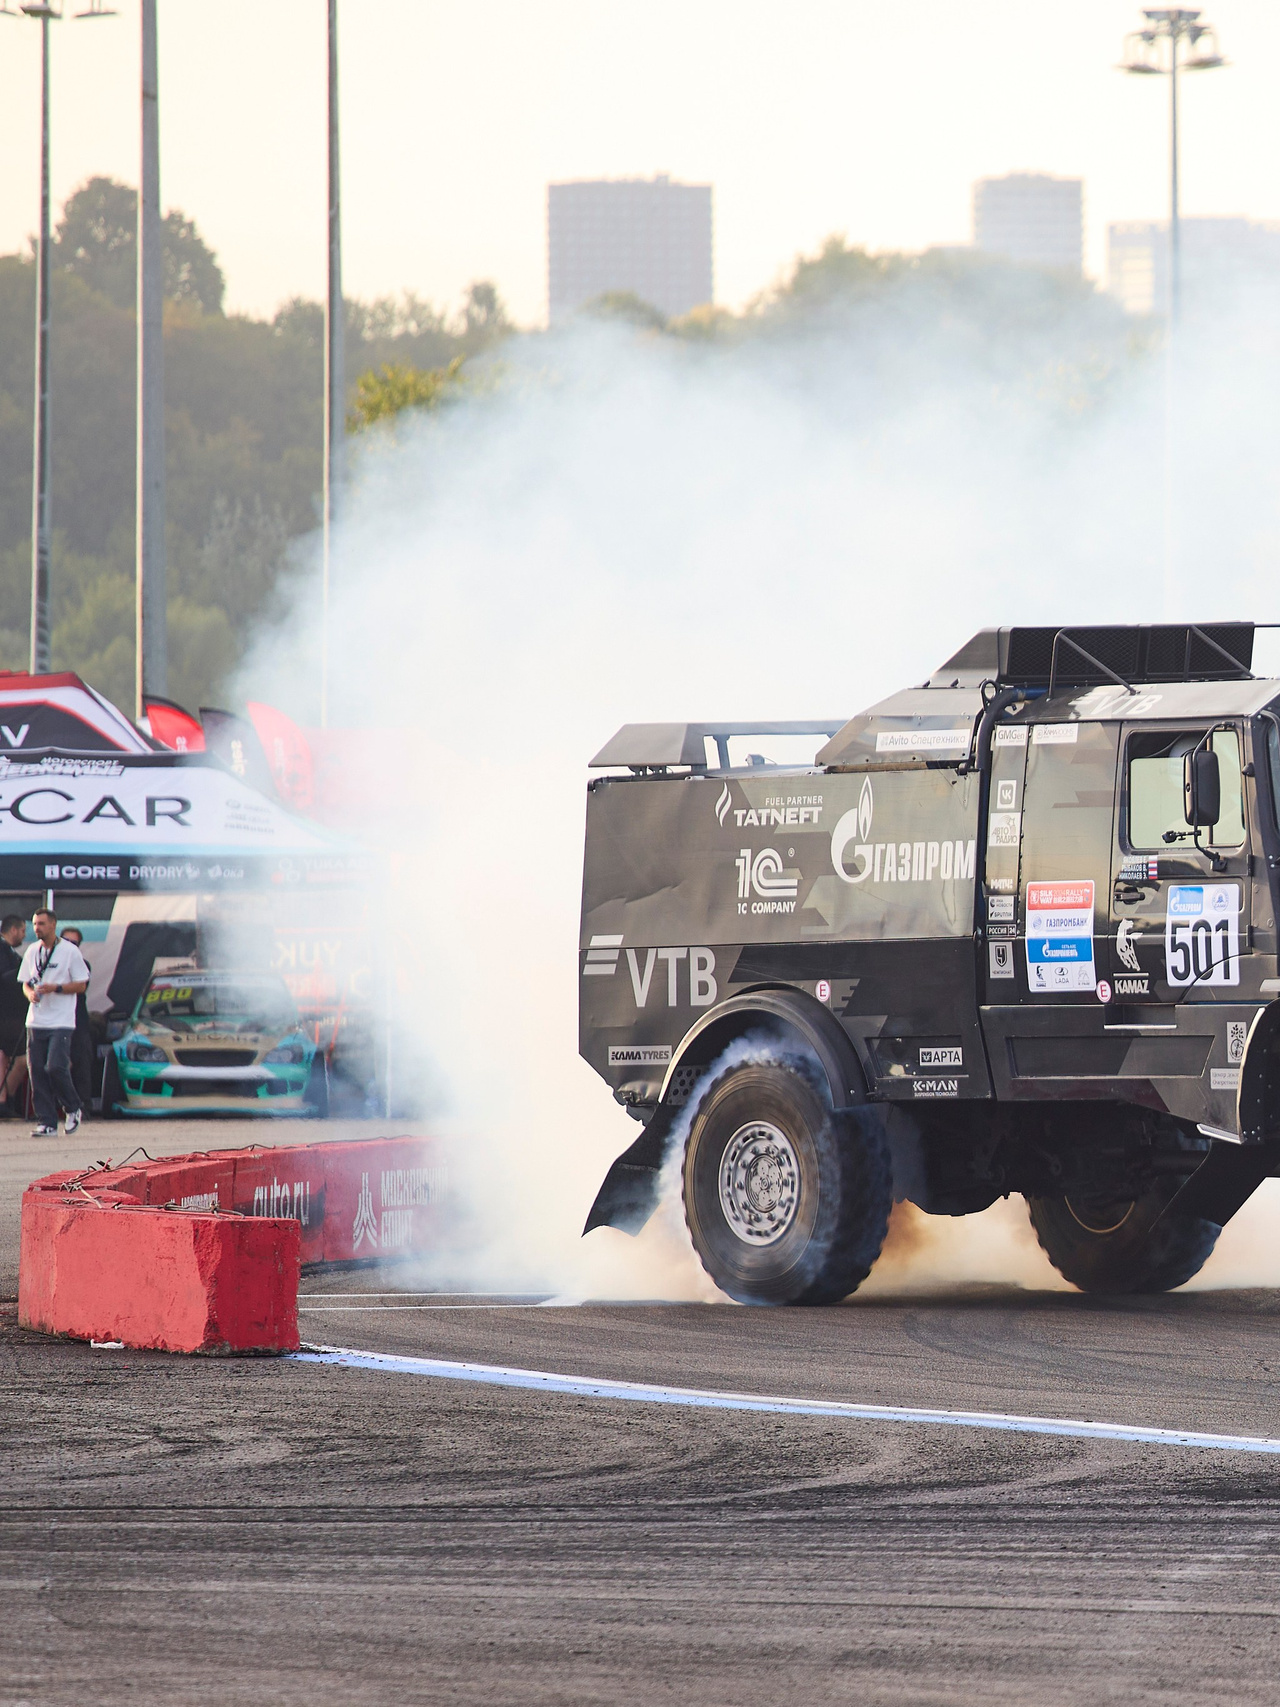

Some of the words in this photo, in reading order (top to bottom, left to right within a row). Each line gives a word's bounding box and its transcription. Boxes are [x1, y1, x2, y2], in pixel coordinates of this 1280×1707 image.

[1090, 694, 1163, 715] VTB
[888, 735, 909, 745] Avito
[911, 734, 966, 746] Спецтехника
[0, 788, 192, 826] CAR
[765, 797, 785, 806] FUEL
[786, 795, 823, 806] PARTNER
[733, 806, 823, 827] TATNEFT
[873, 839, 976, 883] ГАЗПРОМ
[129, 866, 185, 880] DRYDRY
[1040, 889, 1052, 897] SILK
[751, 901, 796, 914] COMPANY
[1178, 902, 1202, 912] GAZPROM
[988, 926, 1007, 935] РОССИЯ
[1008, 926, 1016, 935] 24
[1170, 919, 1231, 981] 501
[625, 947, 718, 1008] VTB
[820, 984, 826, 997] E
[1100, 984, 1108, 998] E
[1115, 980, 1149, 994] KAMAZ
[642, 1050, 669, 1060] TYRES
